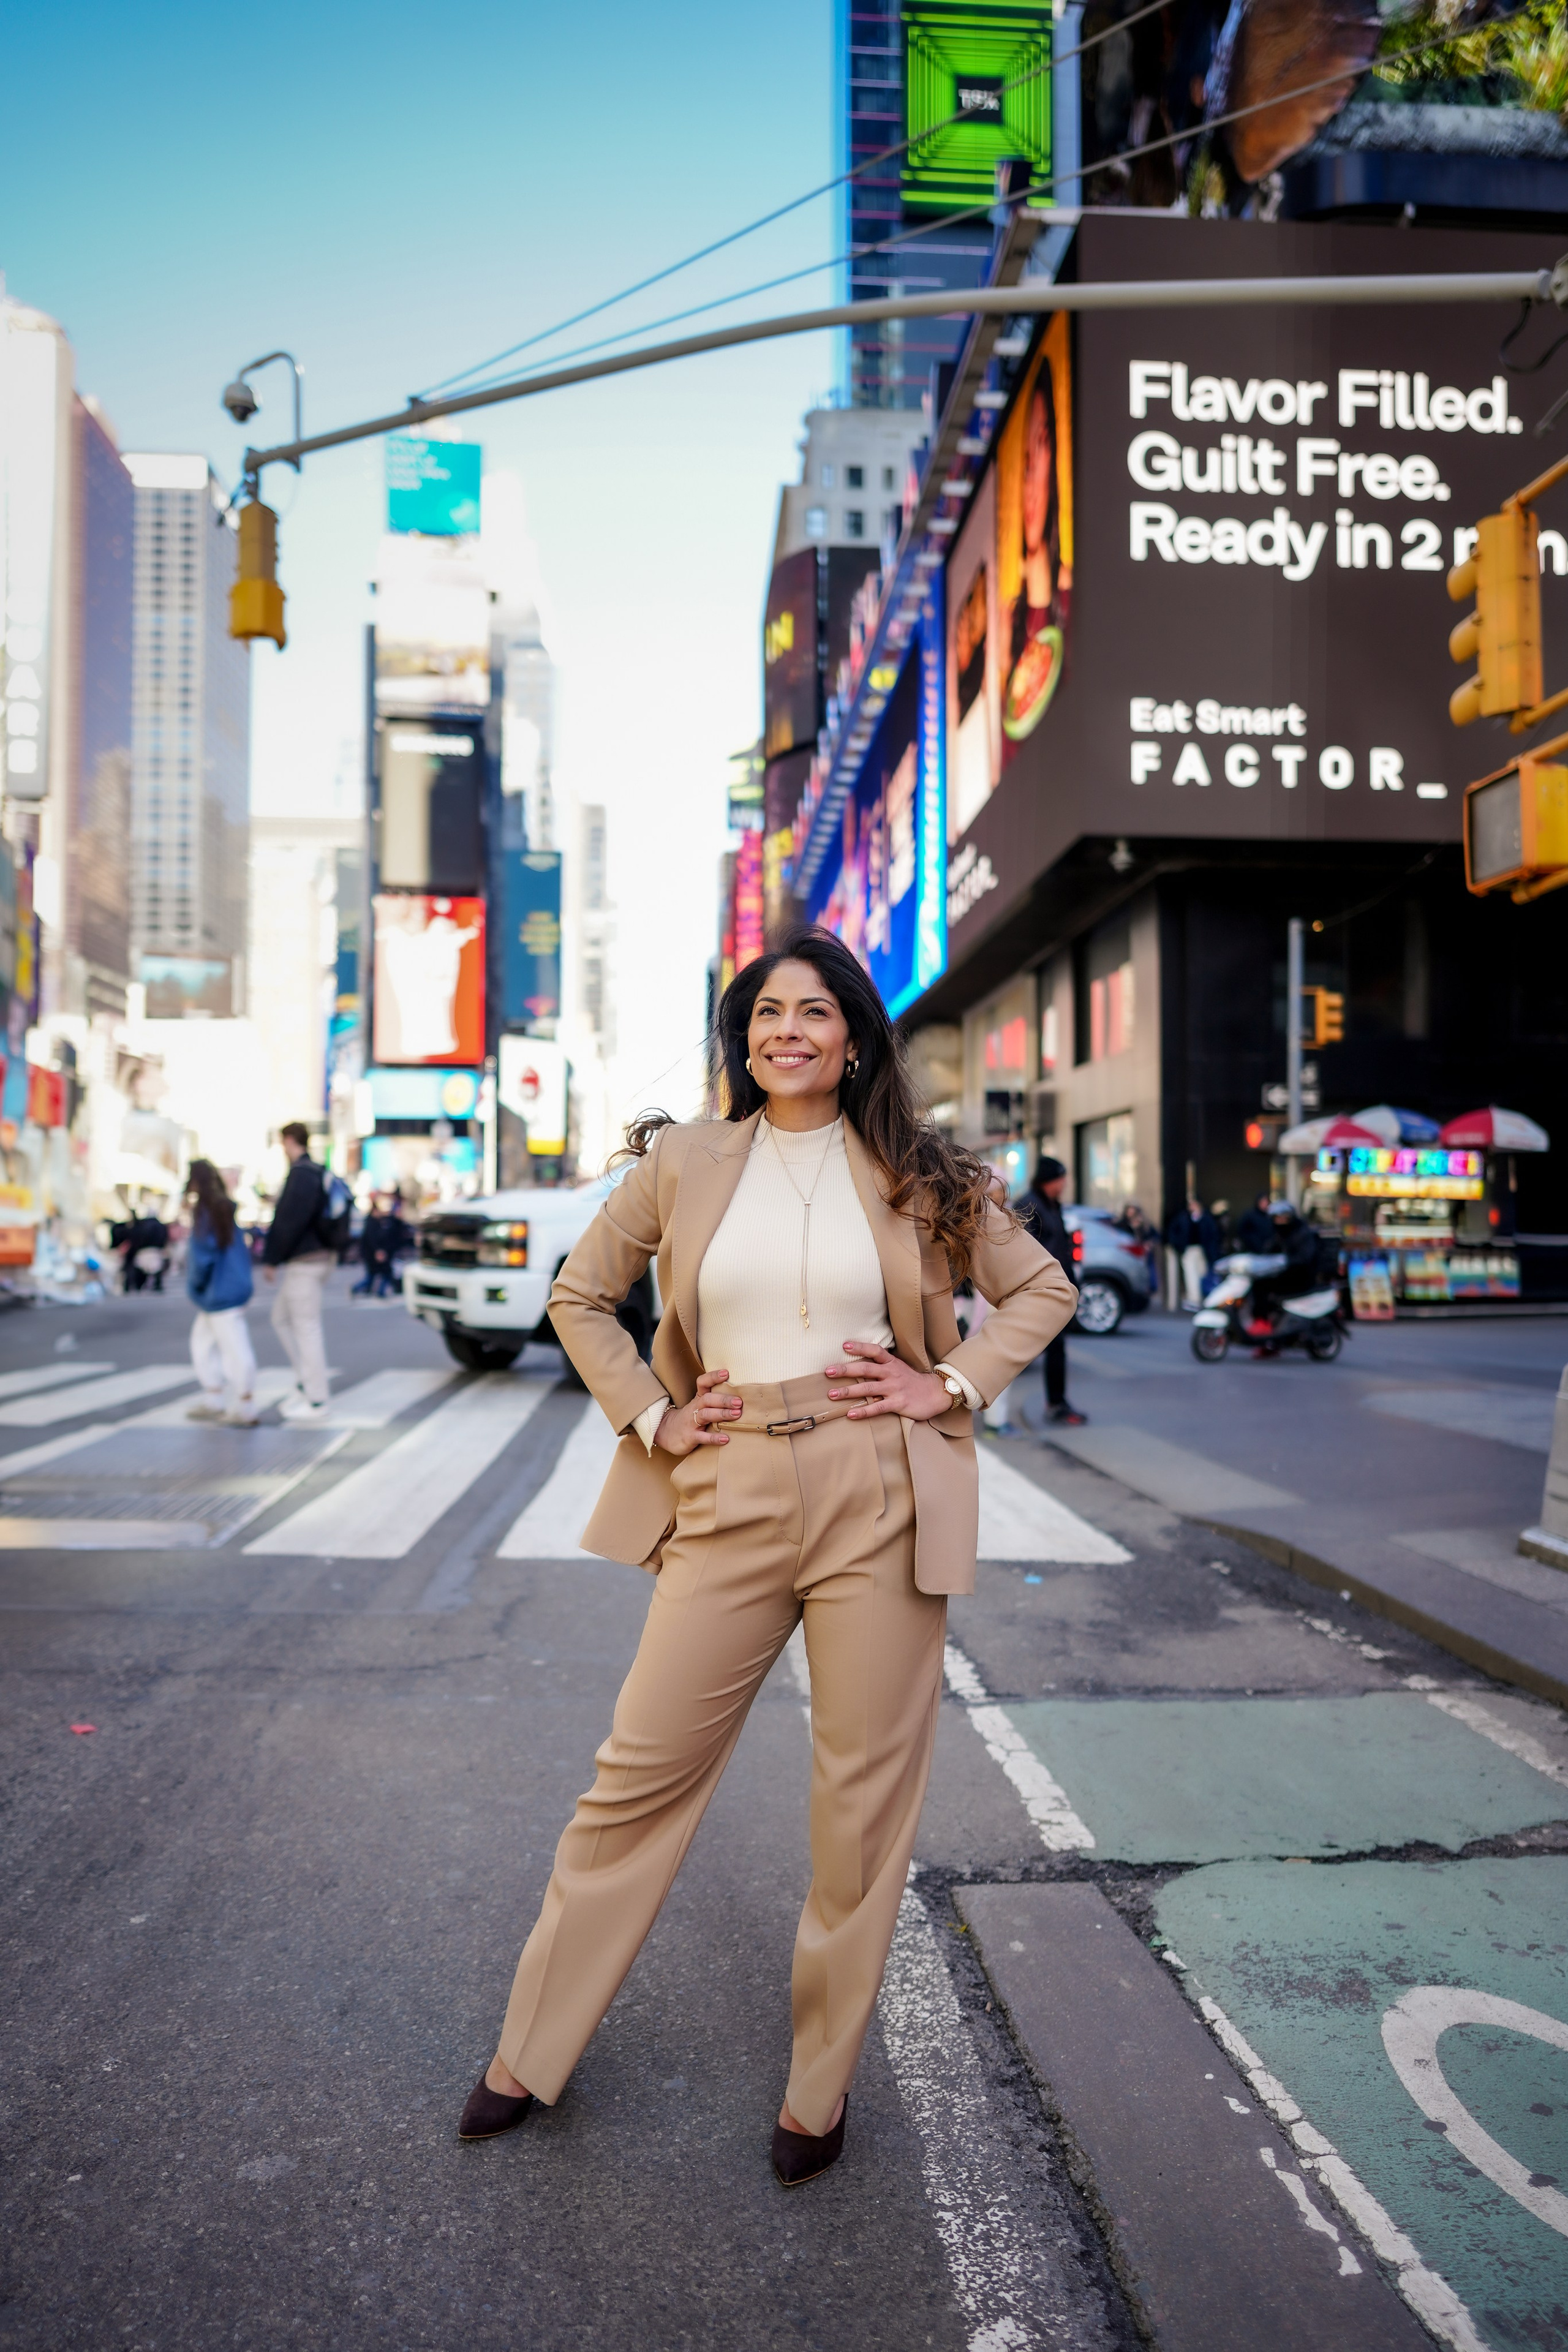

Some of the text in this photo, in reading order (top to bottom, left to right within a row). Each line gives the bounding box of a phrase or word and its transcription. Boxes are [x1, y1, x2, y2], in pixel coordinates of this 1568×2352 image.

[1129, 360, 1523, 434] Flavor Filled.
[1128, 431, 1452, 501] Guilt Free.
[1130, 502, 1328, 581] Ready
[1336, 508, 1393, 570] in
[1401, 519, 1444, 571] 2
[1130, 697, 1306, 736] Eat Smart
